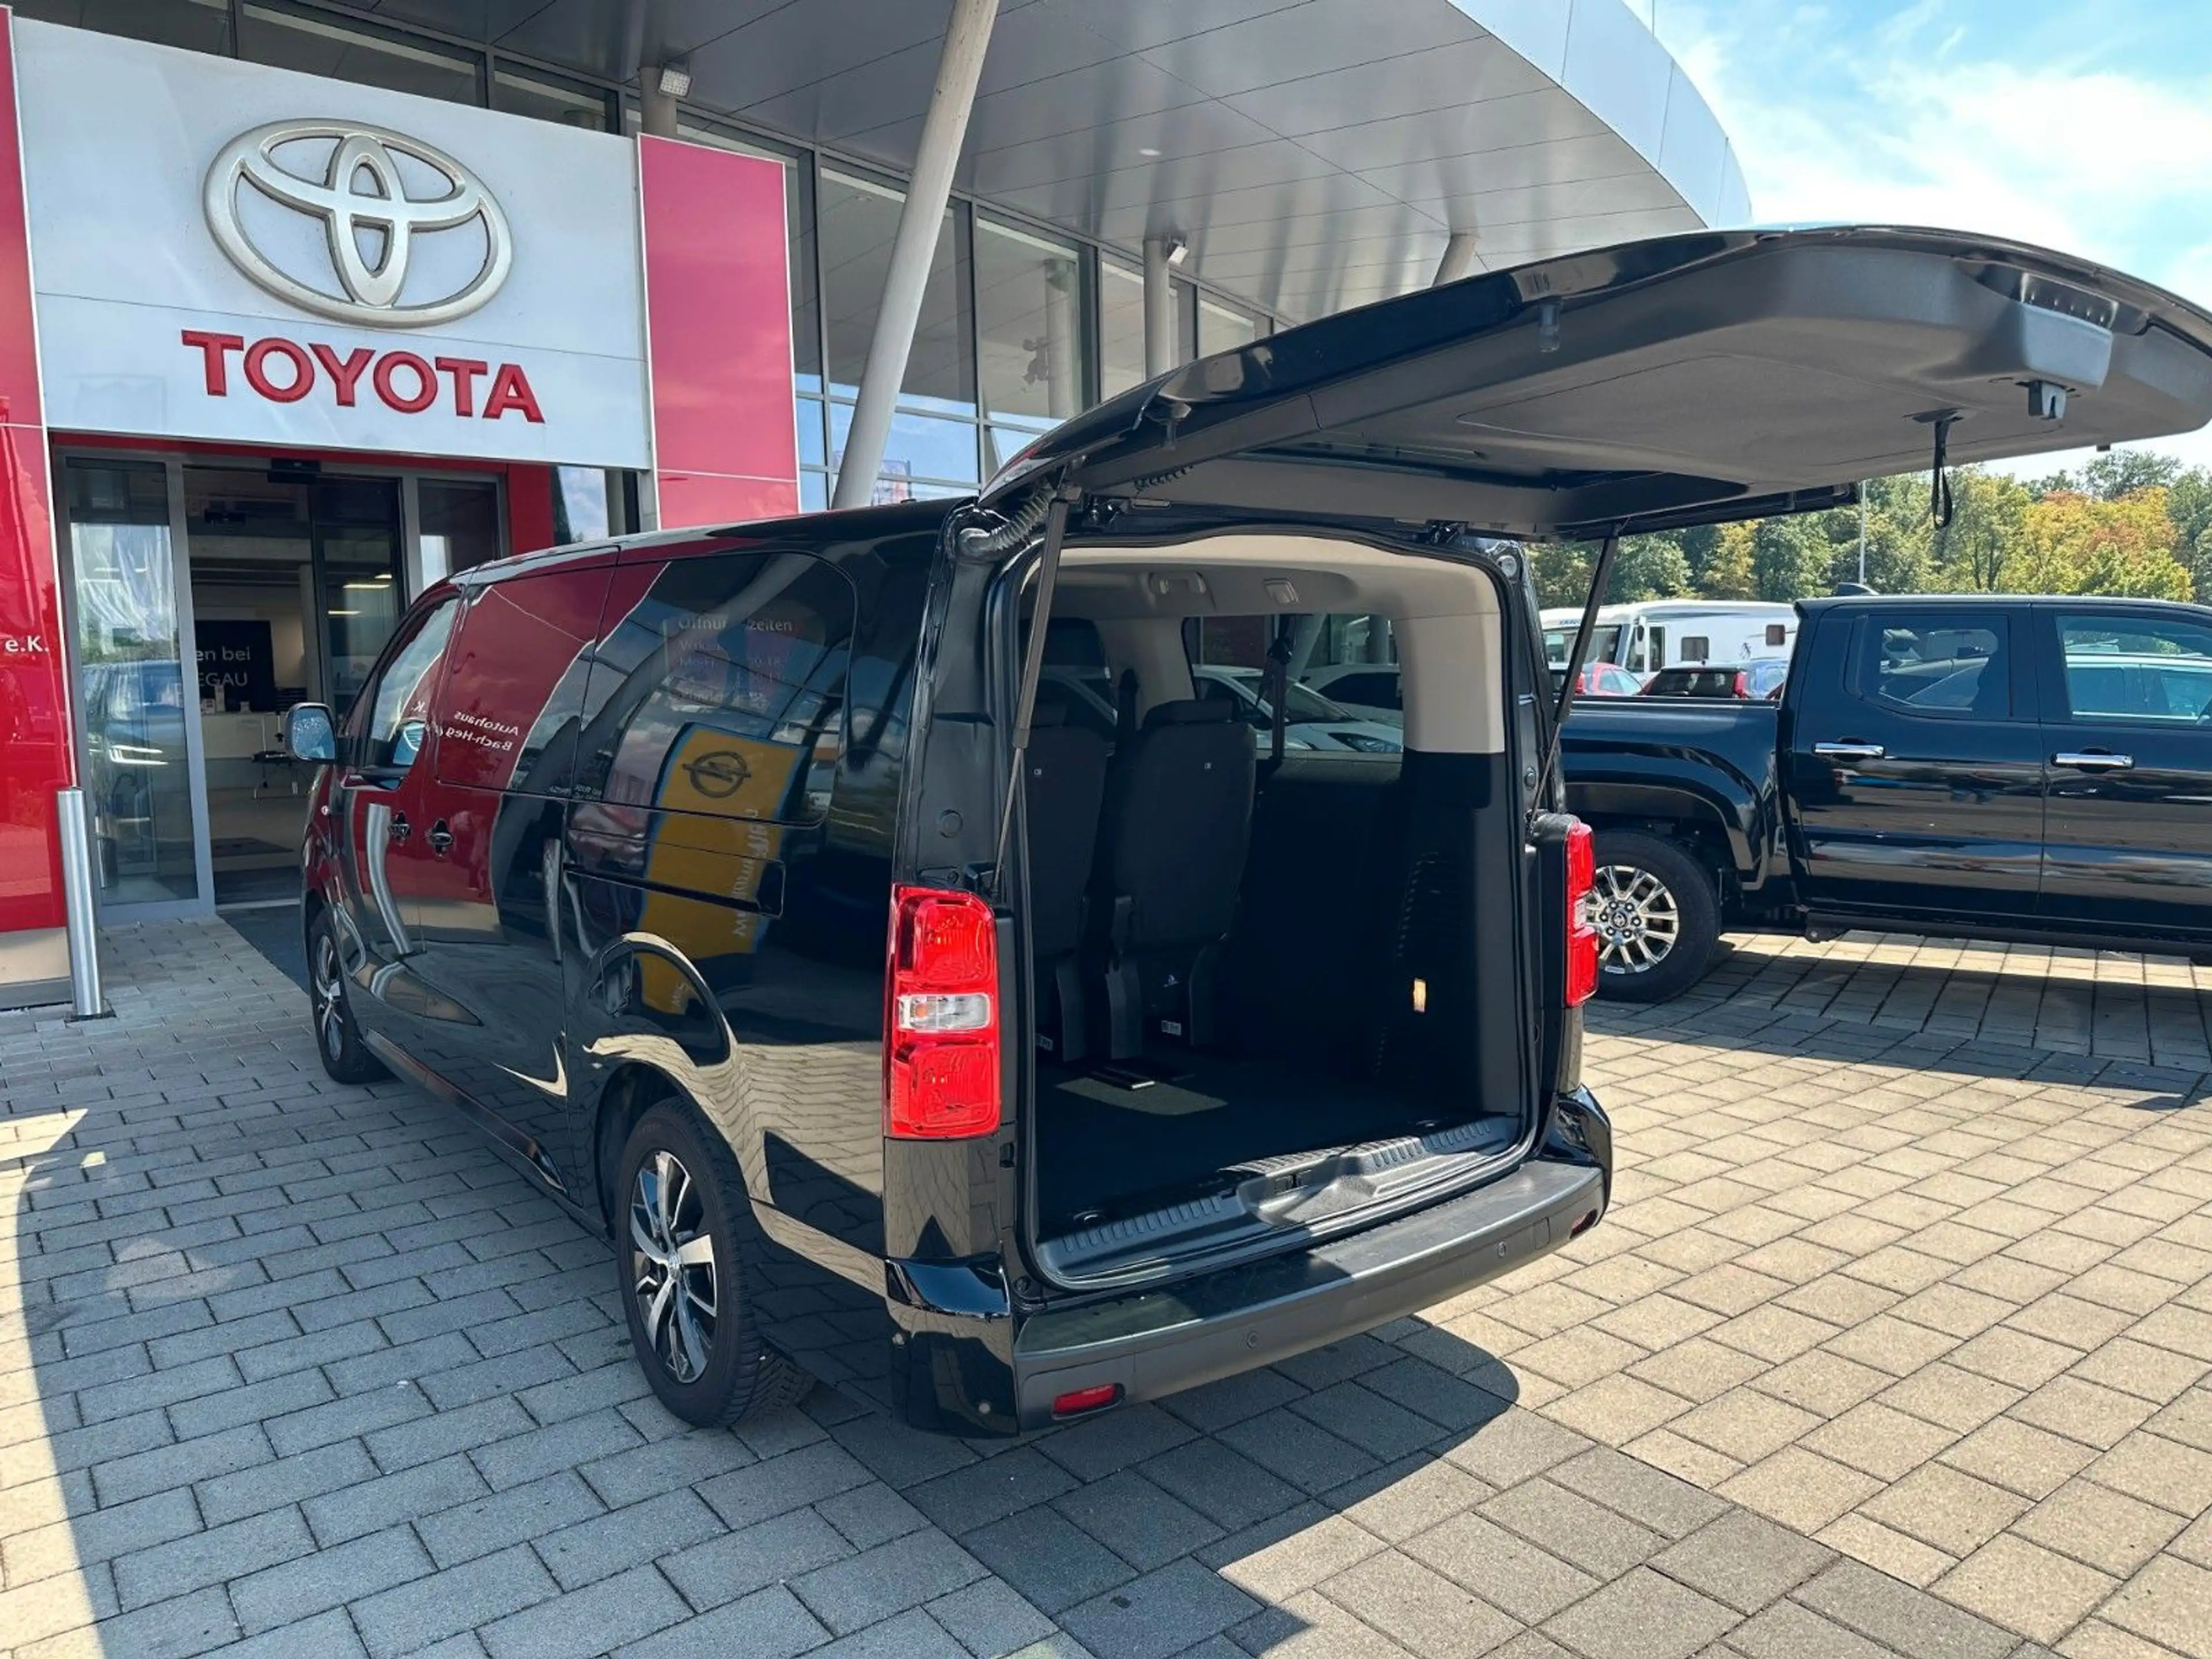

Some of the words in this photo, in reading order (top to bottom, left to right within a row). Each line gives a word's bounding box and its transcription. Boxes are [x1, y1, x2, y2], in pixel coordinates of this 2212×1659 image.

[181, 329, 545, 423] TOYOTA
[5, 635, 50, 652] e.K.
[221, 645, 251, 661] bei
